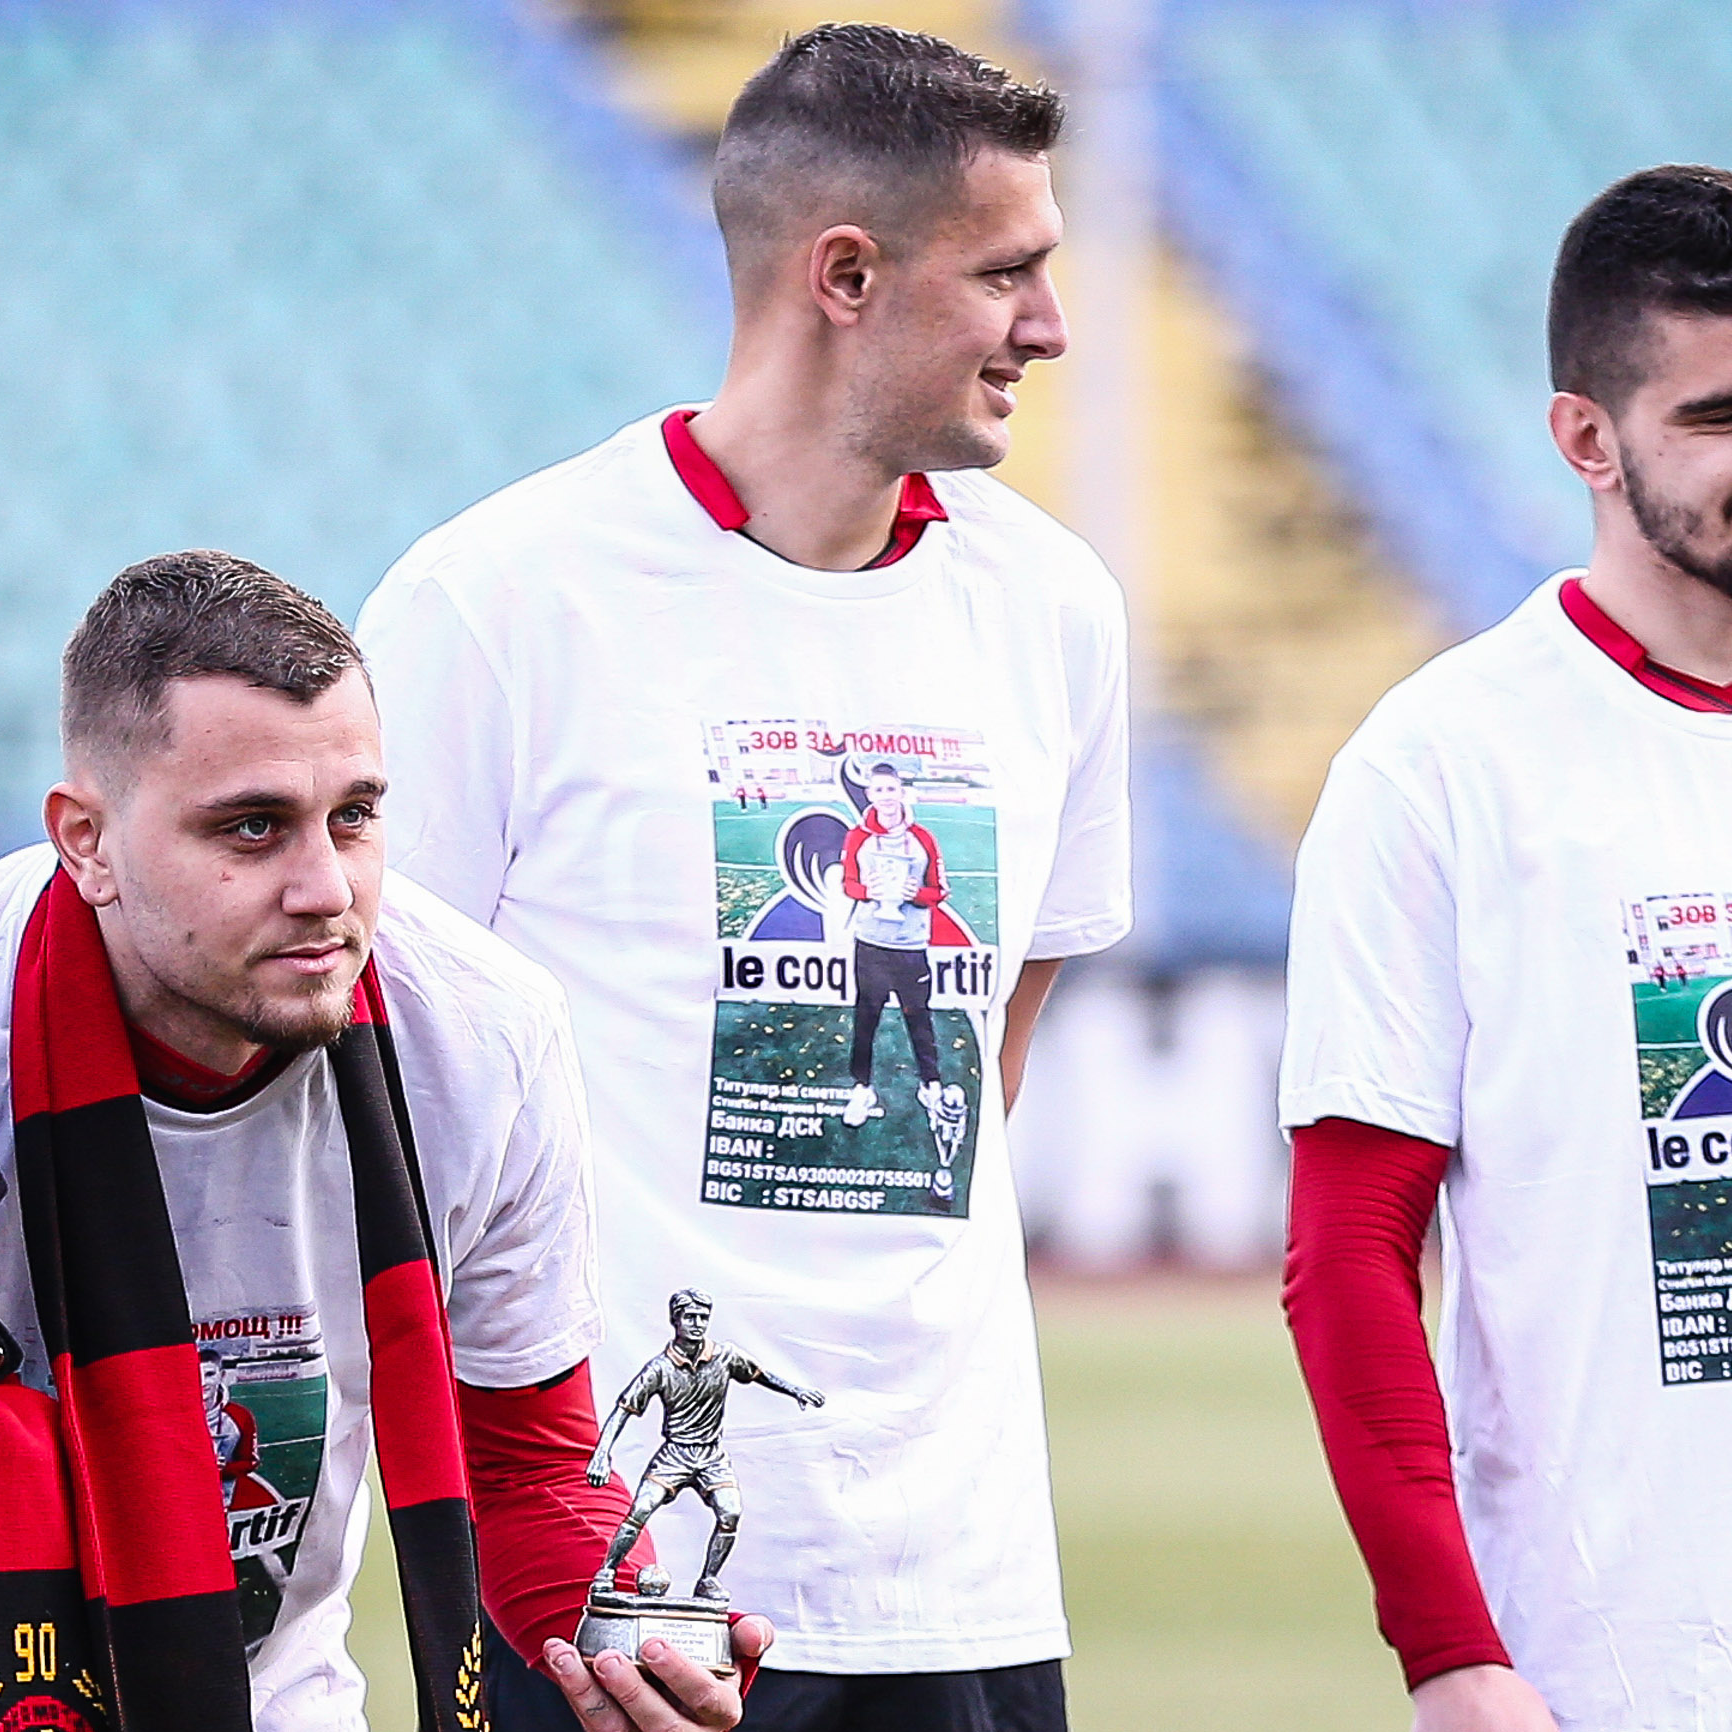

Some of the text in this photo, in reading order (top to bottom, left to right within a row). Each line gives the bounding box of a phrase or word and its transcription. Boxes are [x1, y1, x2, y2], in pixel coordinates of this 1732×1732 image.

[750, 731, 797, 750] ЗОВ
[806, 731, 839, 751] ЗА
[843, 733, 936, 758] ПОМОЩ
[1670, 905, 1715, 925] ЗОВ
[722, 946, 992, 1000] le coq rtif
[711, 1110, 824, 1139] Банка ДСК
[710, 1136, 763, 1158] IBAN
[1647, 1126, 1691, 1171] le
[705, 1181, 743, 1203] BIC
[774, 1187, 886, 1210] STSABGSF
[1659, 1292, 1724, 1313] Банка
[191, 1316, 270, 1341] МОЩ
[1661, 1314, 1715, 1338] IBAN
[230, 1501, 301, 1550] rtif
[14, 1622, 56, 1683] 90
